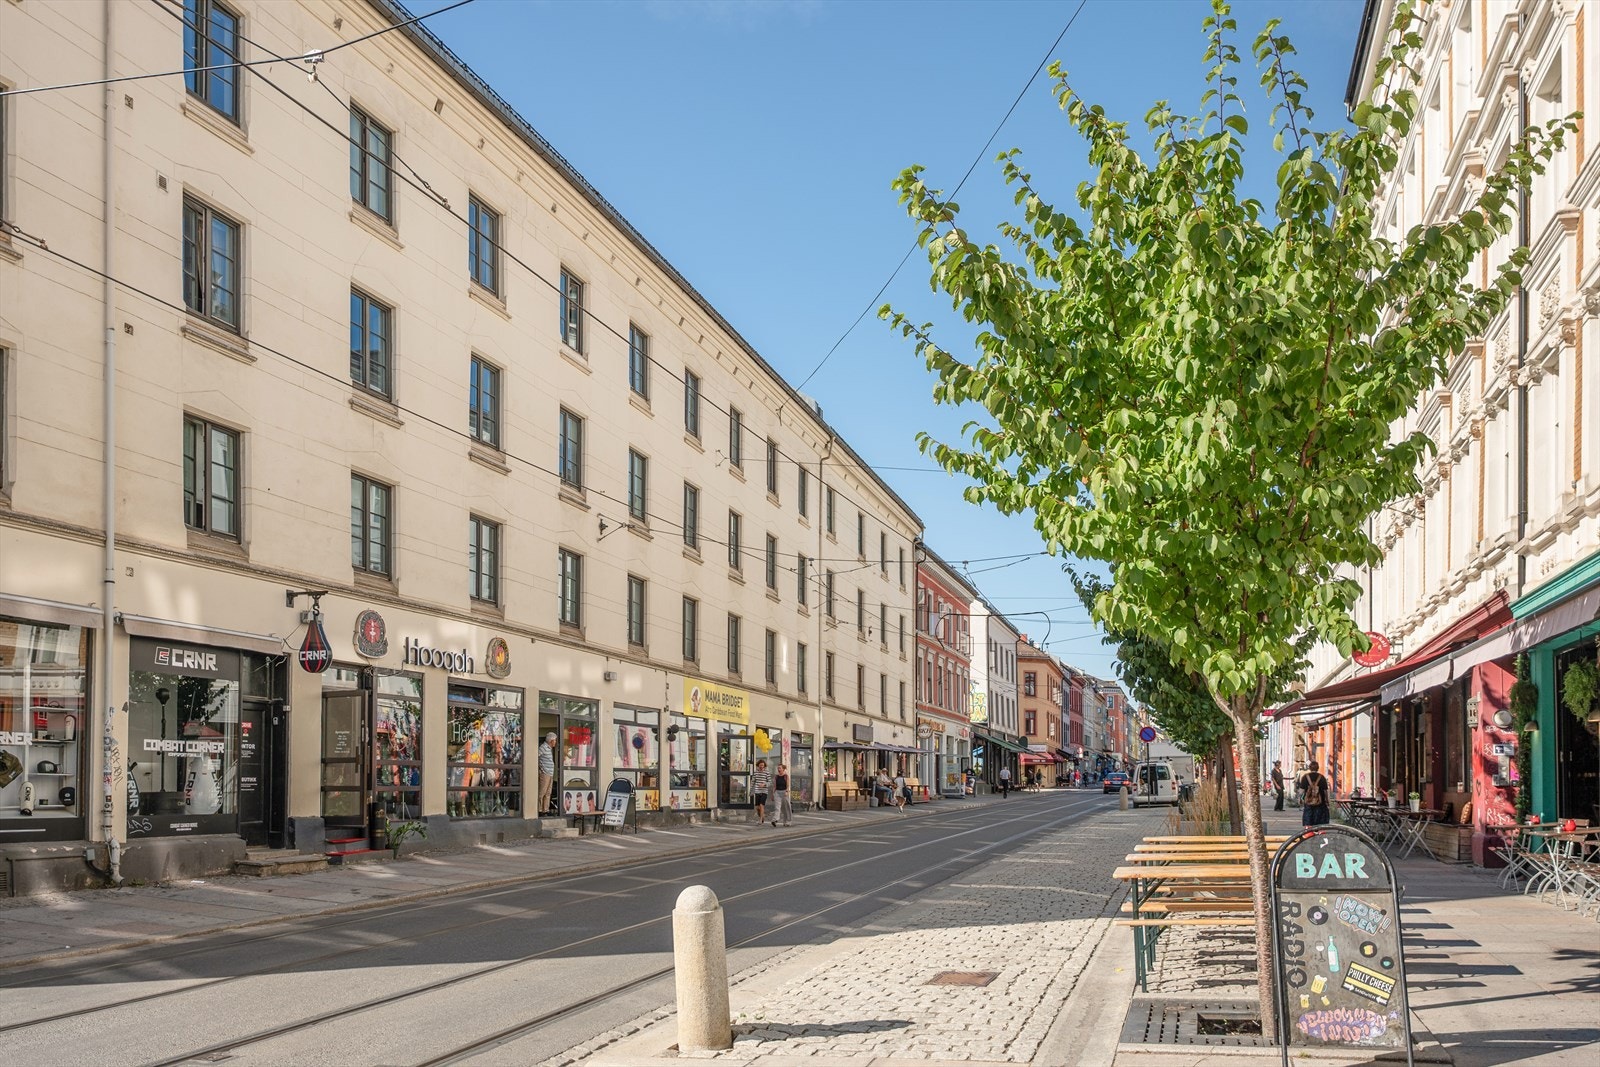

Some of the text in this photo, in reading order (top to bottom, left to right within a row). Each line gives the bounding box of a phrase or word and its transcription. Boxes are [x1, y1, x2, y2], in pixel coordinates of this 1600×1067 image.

[299, 649, 327, 661] CRNR
[704, 689, 744, 709] MAMA BRIDGET
[143, 739, 225, 753] COMBAT CORNER
[1295, 852, 1369, 879] BAR
[1280, 900, 1308, 989] RADIO
[1347, 968, 1394, 994] PHILLY CHEESE
